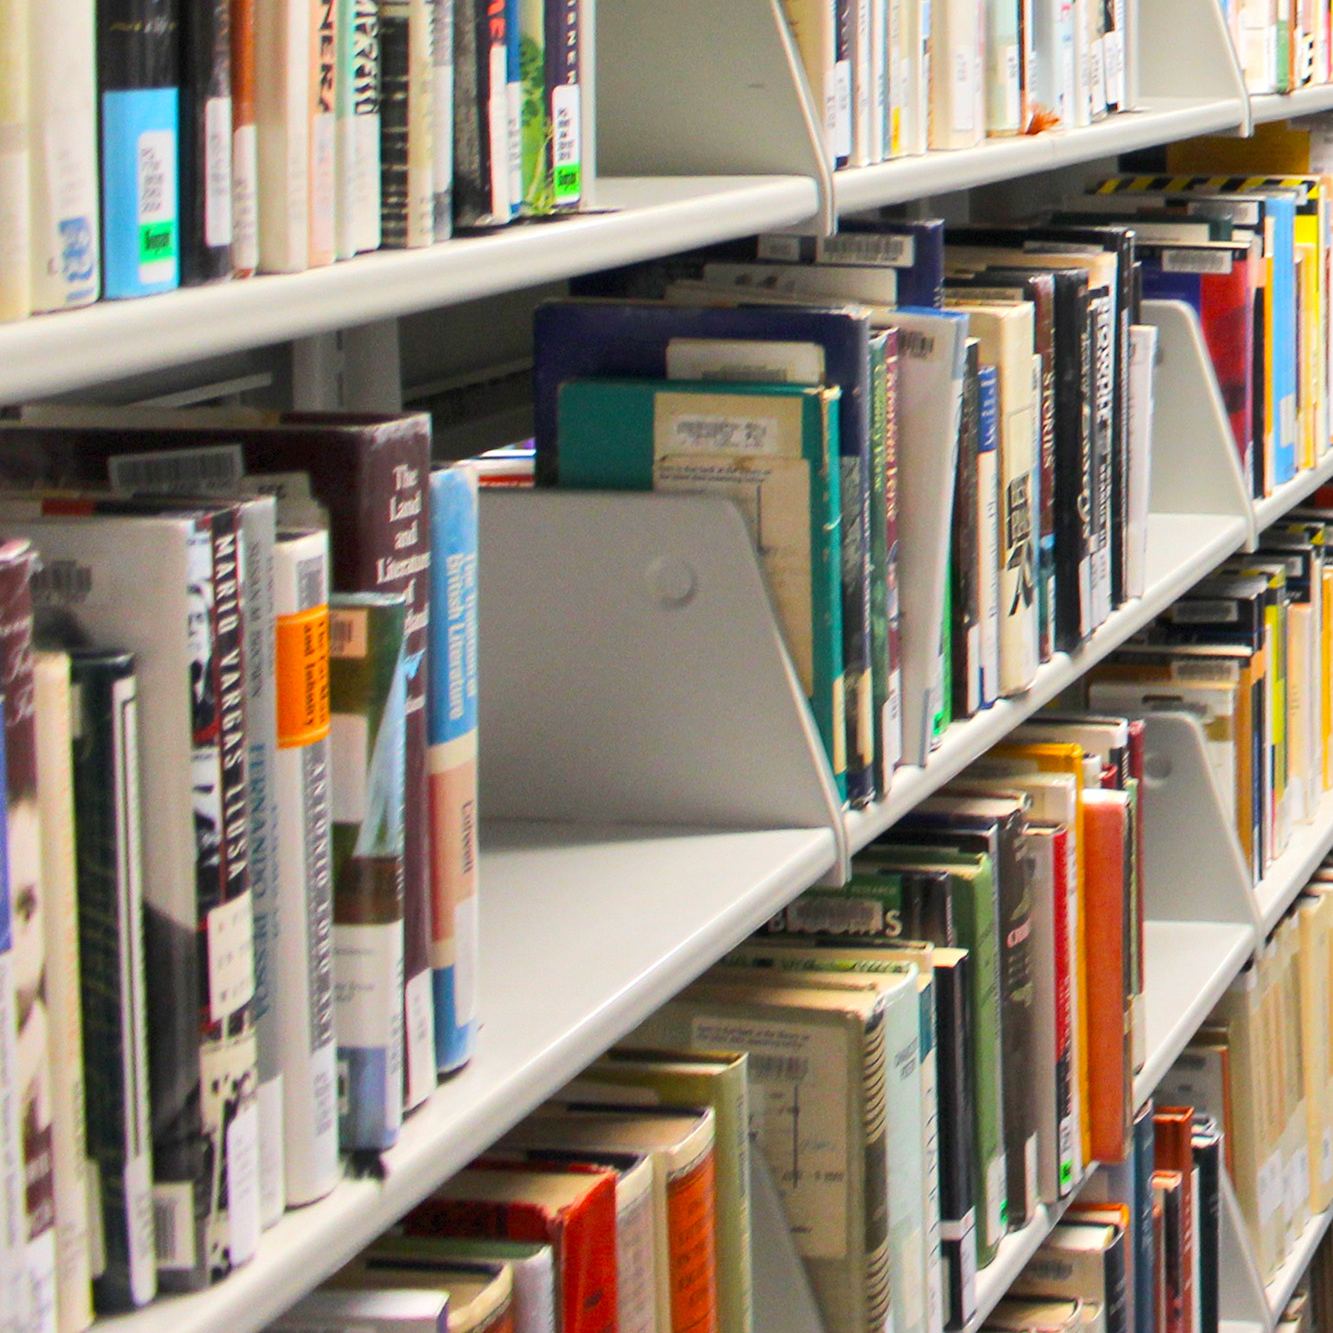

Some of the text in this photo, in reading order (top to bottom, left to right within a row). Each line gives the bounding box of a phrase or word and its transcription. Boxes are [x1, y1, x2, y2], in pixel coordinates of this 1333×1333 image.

[1041, 370, 1056, 469] STORIES
[388, 489, 422, 523] Land
[392, 463, 418, 491] The
[394, 519, 418, 551] and
[302, 624, 316, 659] and
[446, 552, 467, 722] British Literature
[216, 533, 248, 882] MARIO VARGAS LLOSA
[249, 742, 268, 901] FERNANDO
[311, 762, 328, 888] ANTONIO
